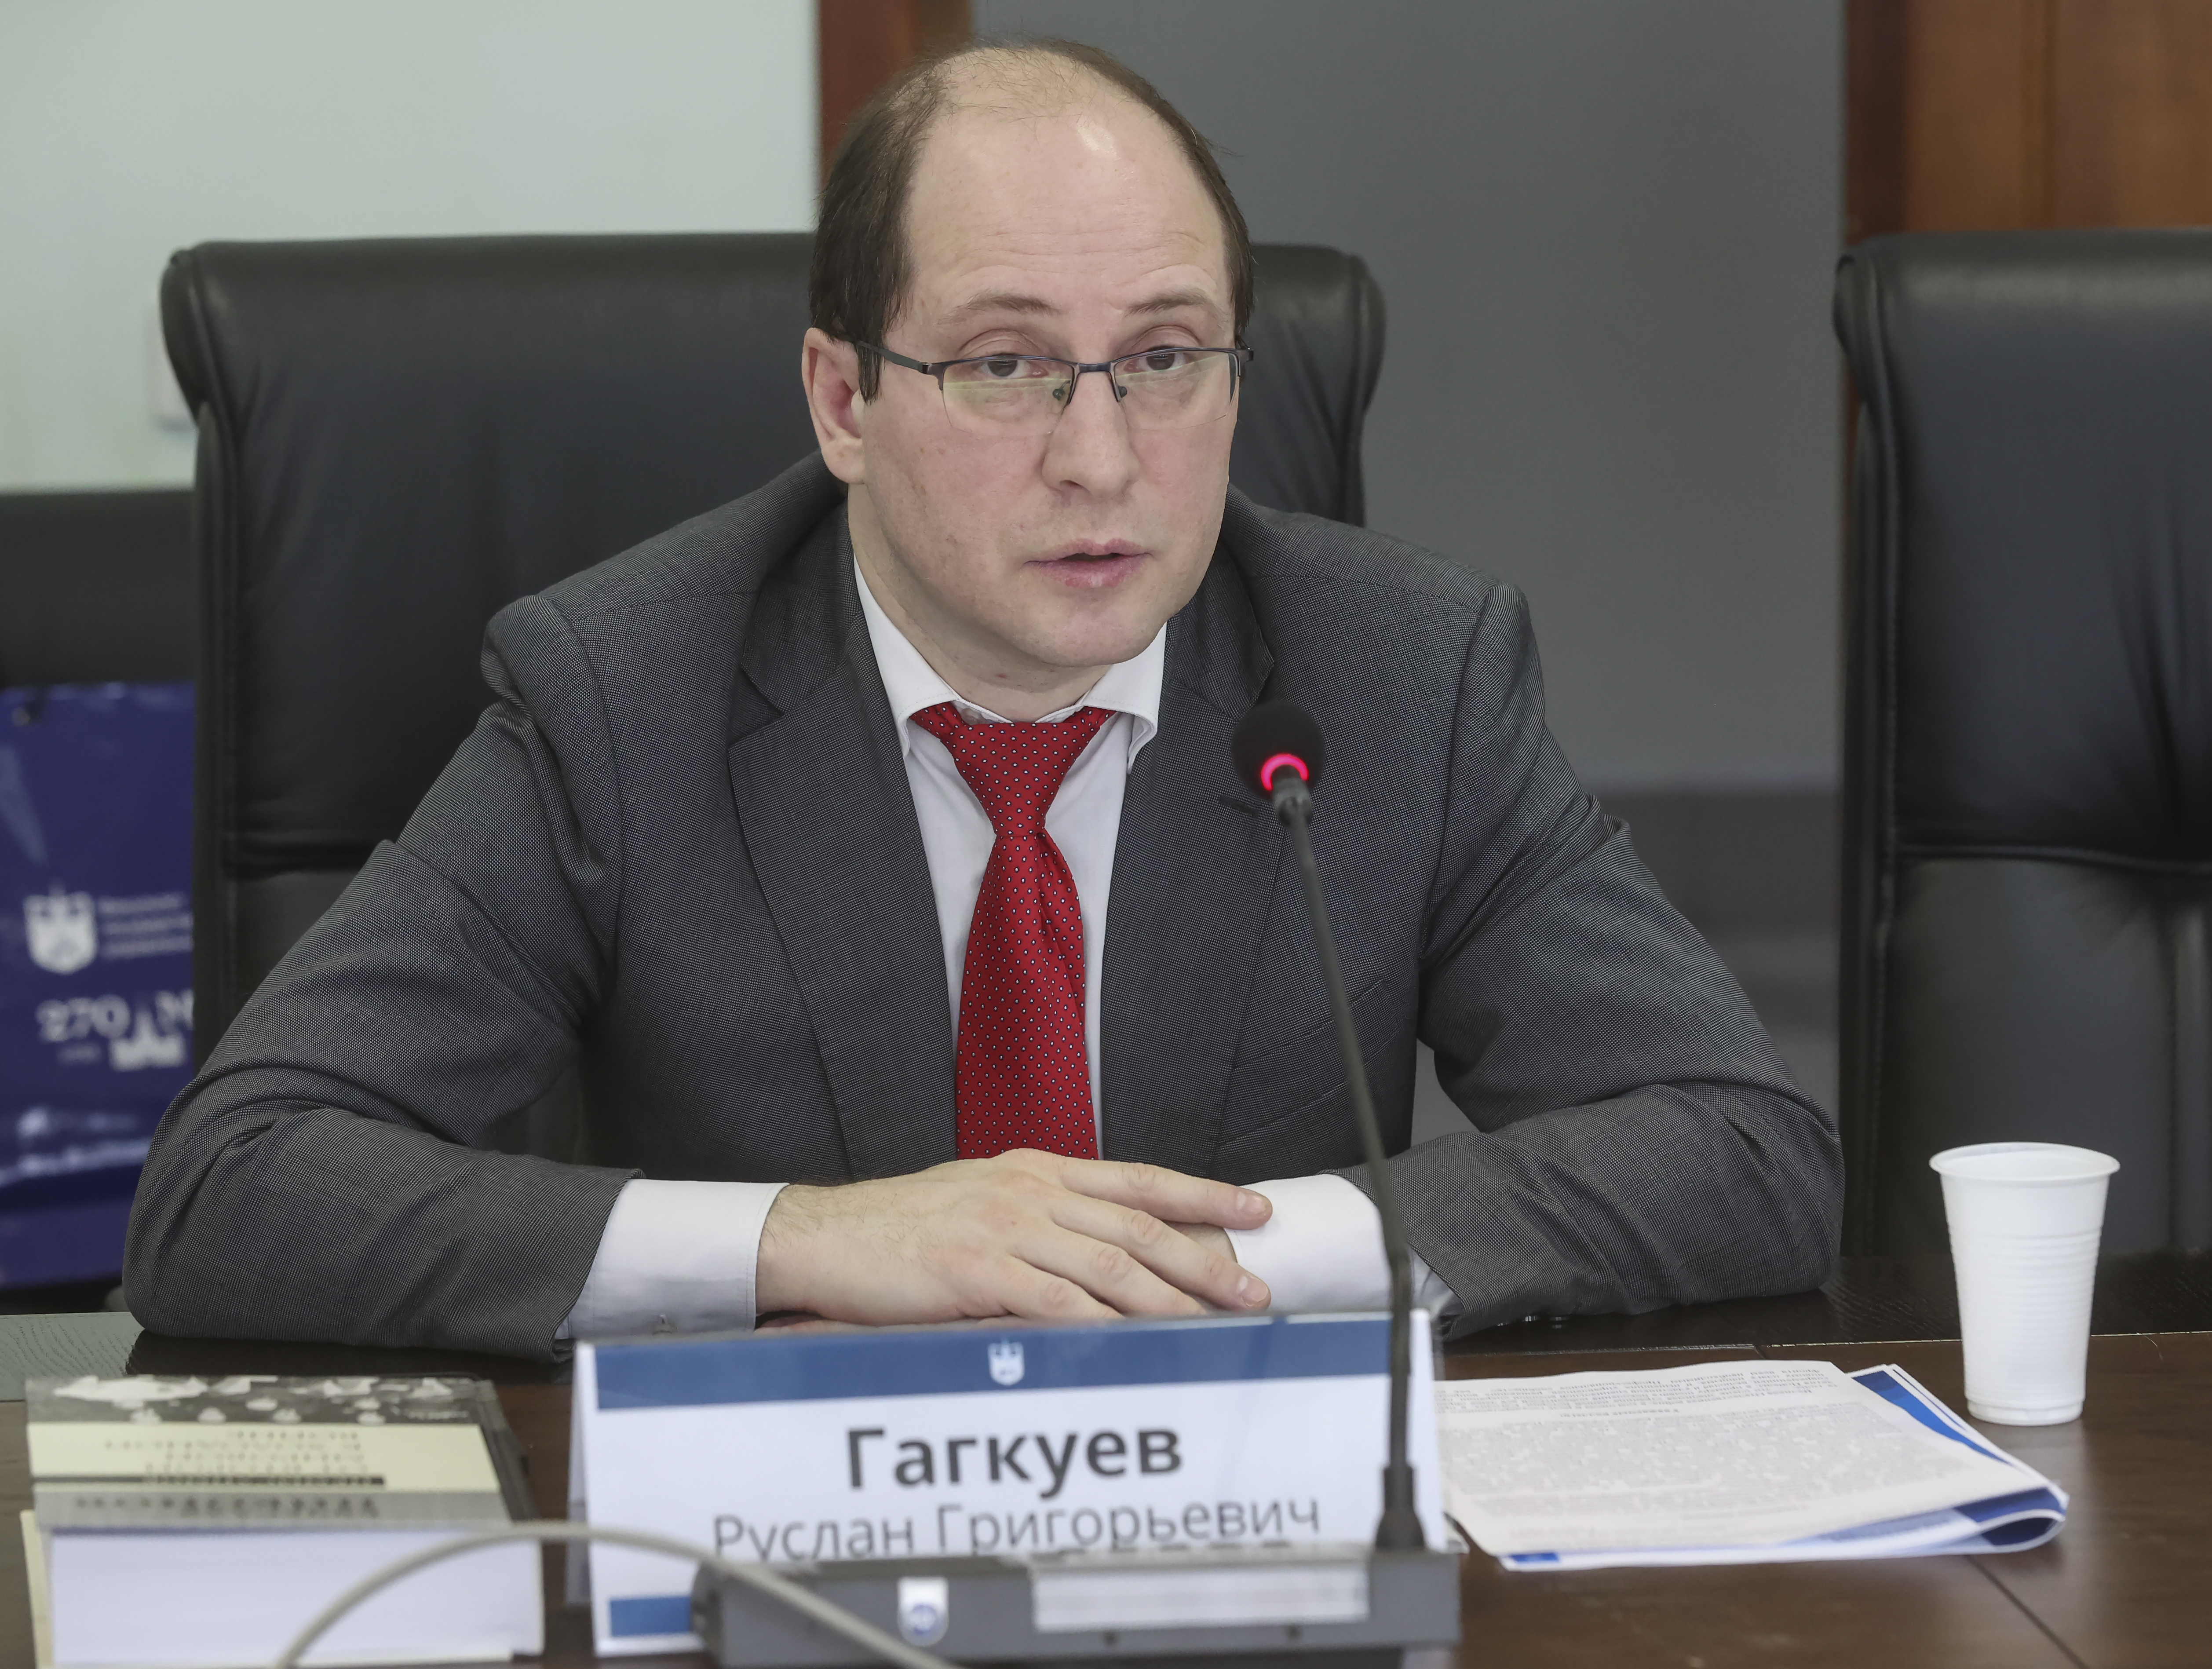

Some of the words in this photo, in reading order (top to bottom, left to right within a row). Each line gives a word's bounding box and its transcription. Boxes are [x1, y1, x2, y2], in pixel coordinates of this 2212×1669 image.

[847, 1428, 1183, 1499] Гагкуев
[714, 1514, 914, 1562] Руслан
[937, 1498, 1321, 1556] Григорьевич
